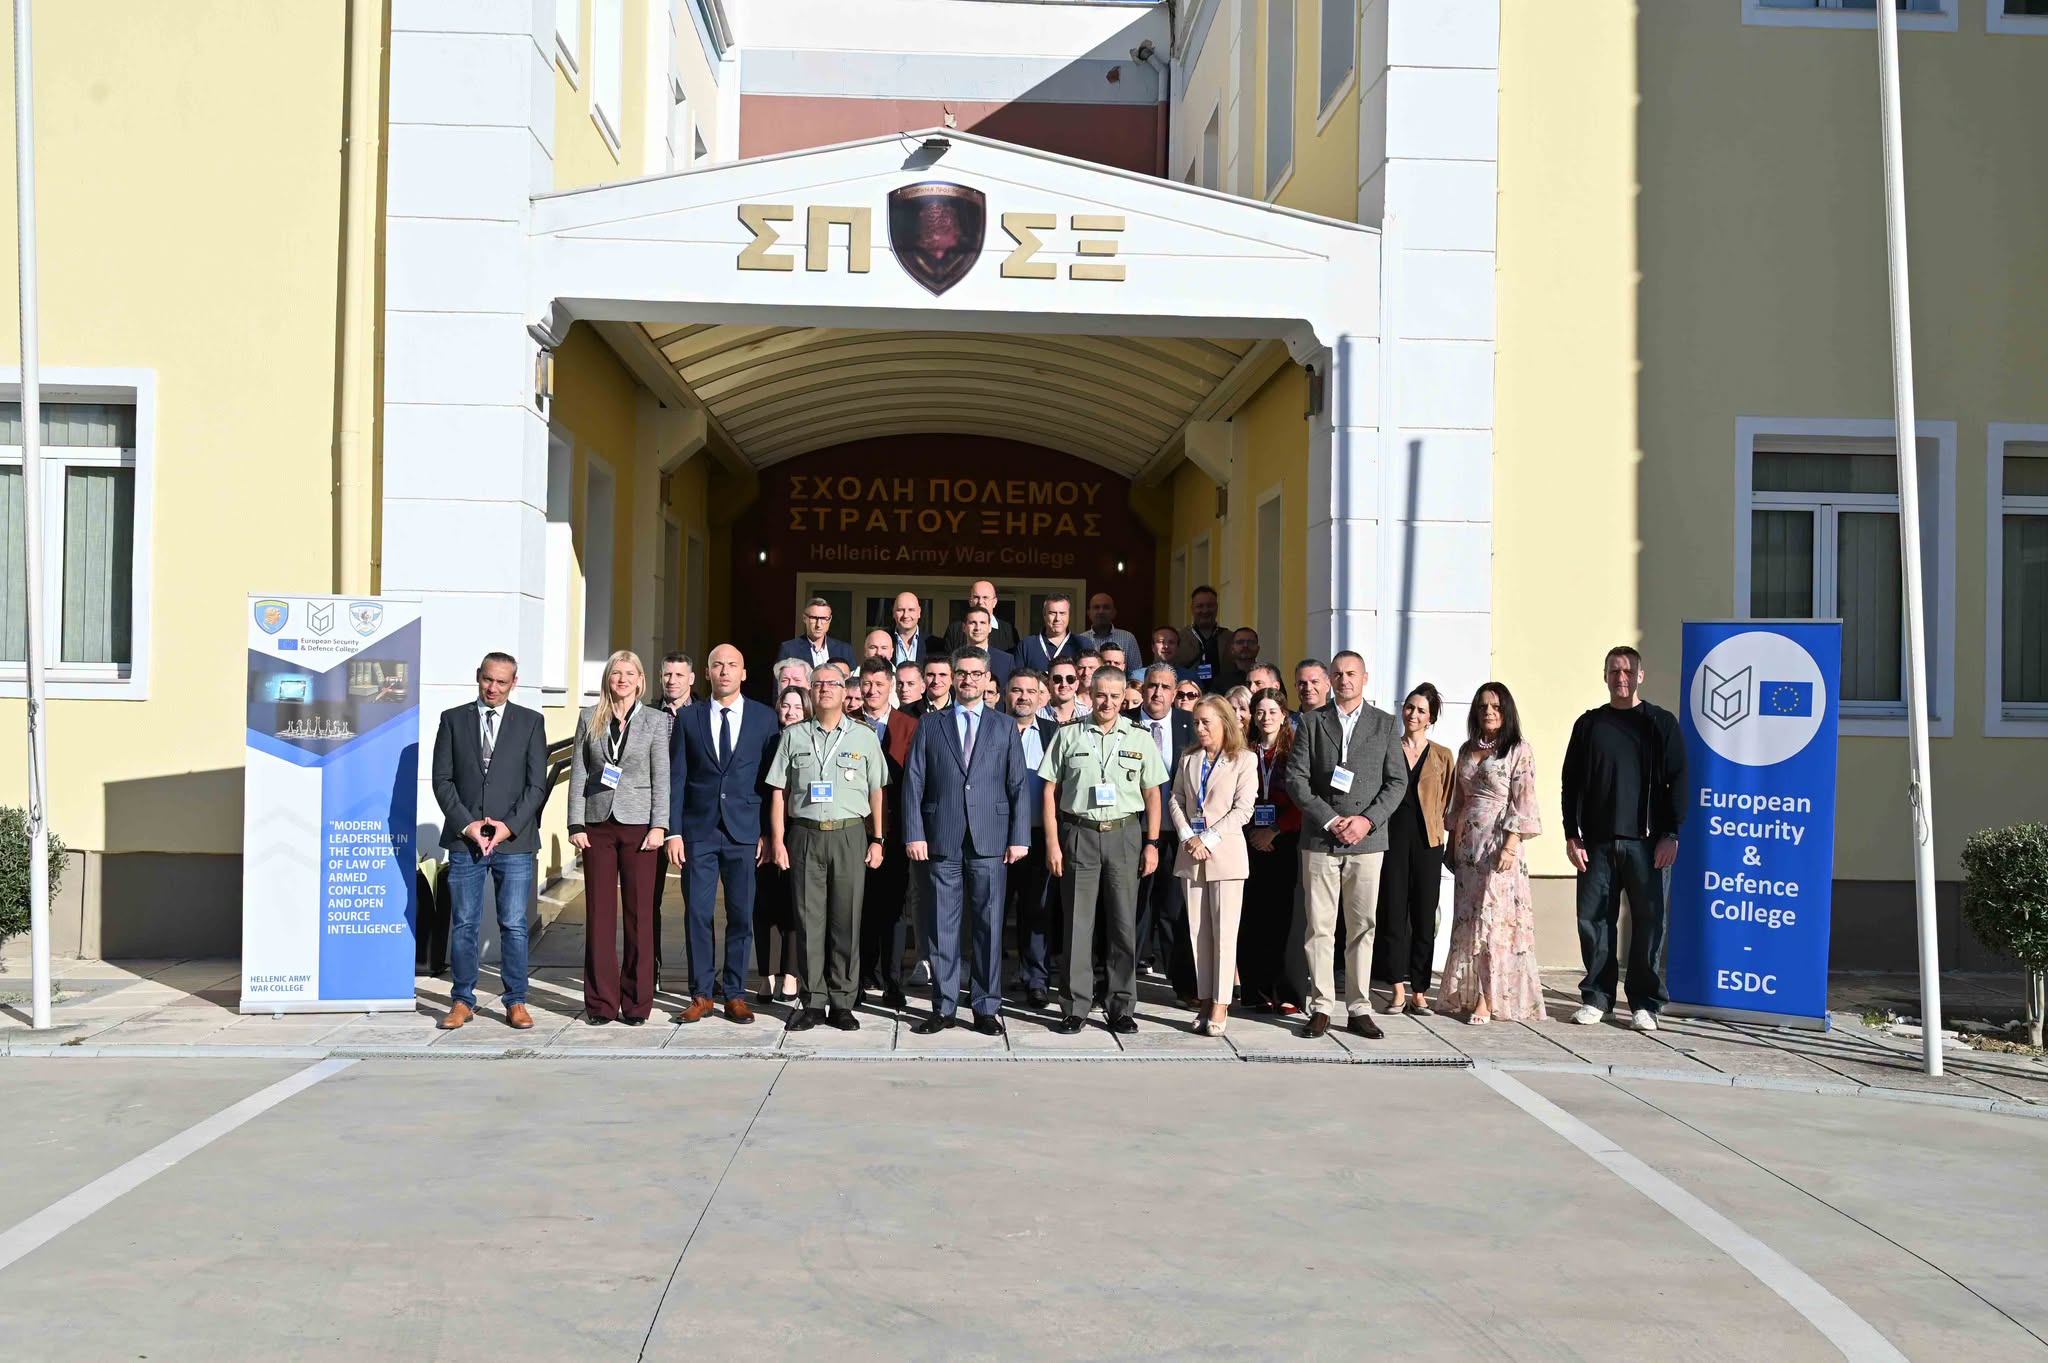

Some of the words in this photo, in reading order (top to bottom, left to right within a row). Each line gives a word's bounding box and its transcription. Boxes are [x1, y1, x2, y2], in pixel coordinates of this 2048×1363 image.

[790, 476, 914, 502] ΣΧΟΛΗ
[928, 478, 1104, 505] ΠΟΛΕΜΟΥ
[789, 507, 968, 533] ΣΤΡΑΤΟΥ
[980, 510, 1104, 537] ΞΗΡΑΣ
[810, 543, 891, 562] Hellenic
[895, 544, 949, 566] Army
[955, 546, 994, 564] War
[1000, 547, 1075, 569] College
[300, 637, 332, 645] European
[333, 638, 359, 646] Security
[1699, 787, 1811, 815] European
[329, 820, 382, 831] "MODERN
[1709, 816, 1805, 846] Security
[329, 833, 395, 844] LEADERSHIP
[397, 834, 408, 843] IN
[328, 846, 350, 857] THE
[352, 846, 401, 857] CONTEXT
[1742, 845, 1762, 867] &
[328, 859, 343, 870] OF
[345, 859, 370, 870] LAW
[371, 859, 387, 870] OF
[328, 872, 368, 882] ARMED
[1704, 871, 1800, 898] Defence
[328, 885, 386, 896] CONFLICTS
[328, 898, 352, 908] AND
[354, 898, 384, 908] OPEN
[327, 911, 370, 922] SOURCE
[1710, 900, 1796, 929] College
[327, 924, 407, 935] INTELLIGENCE"
[250, 975, 287, 983] HELLENIC
[288, 975, 312, 983] ARMY
[1717, 969, 1777, 995] ESDC
[250, 984, 269, 992] WAR
[269, 984, 304, 992] COLLEGE
